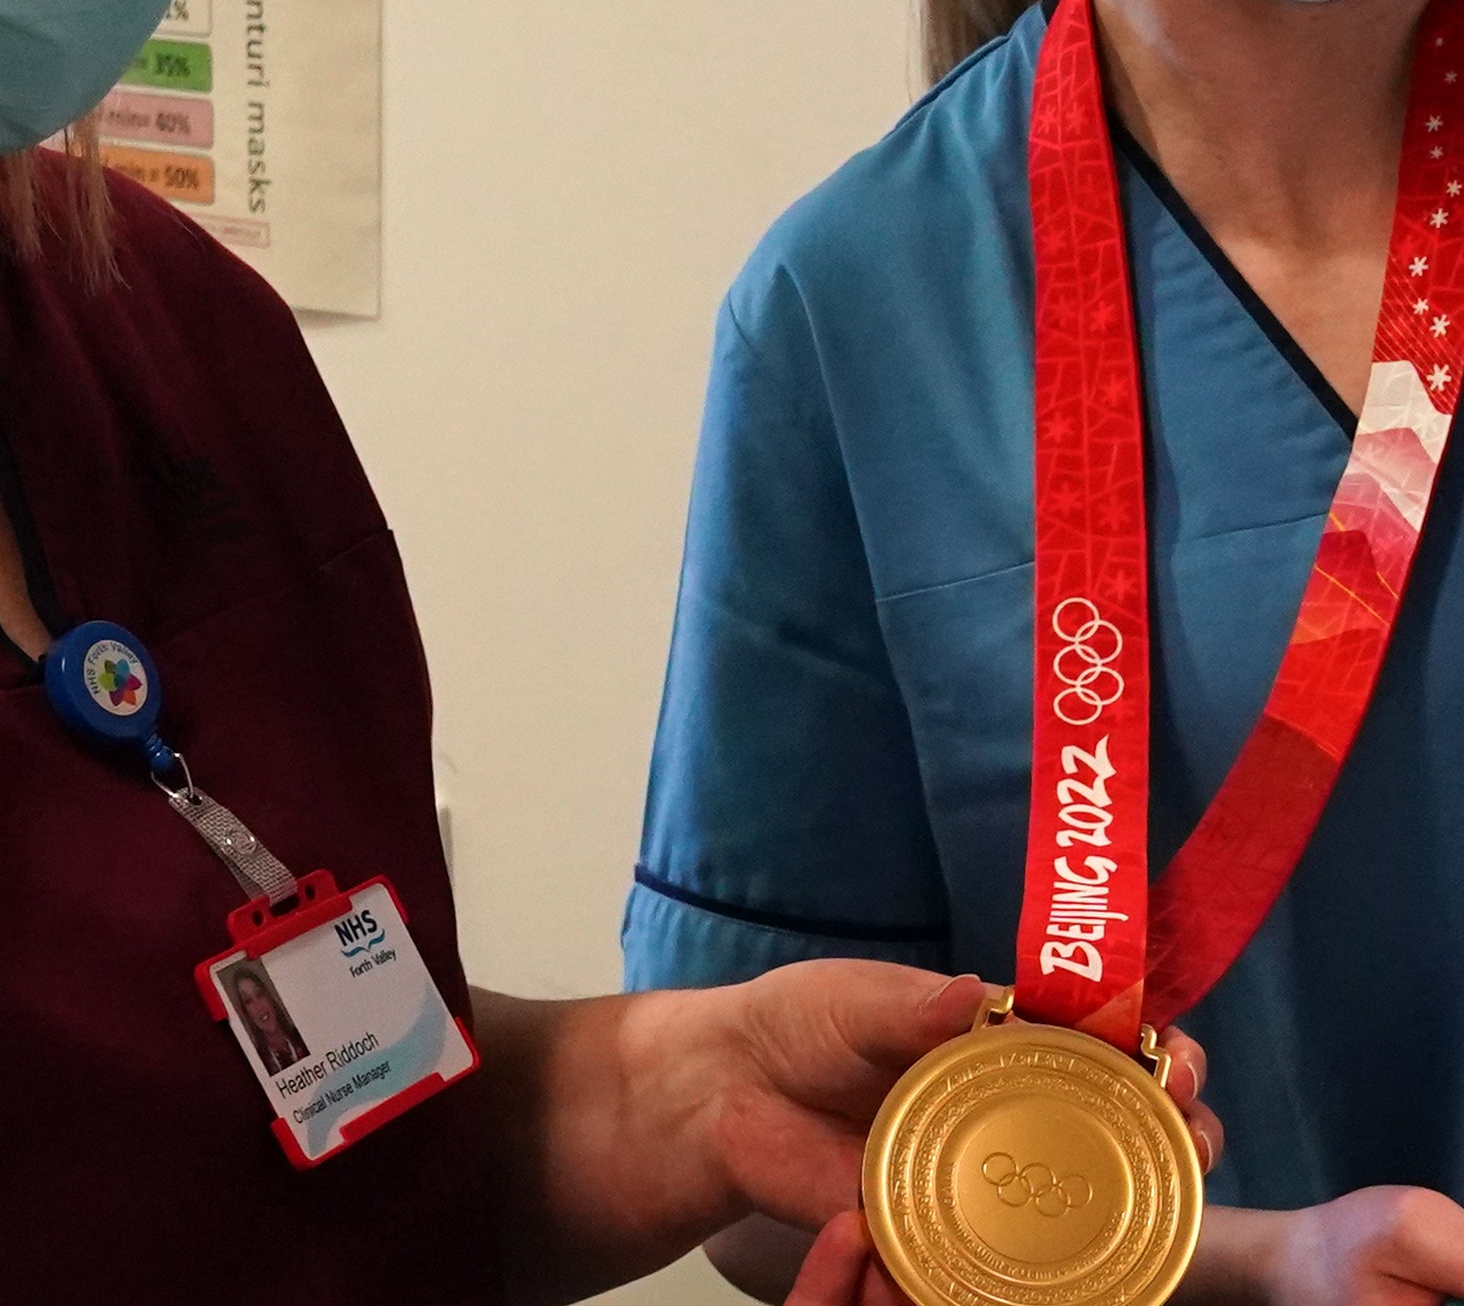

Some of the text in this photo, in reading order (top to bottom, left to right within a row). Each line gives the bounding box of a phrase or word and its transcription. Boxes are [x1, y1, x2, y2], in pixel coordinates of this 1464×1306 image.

[246, 101, 272, 216] masks
[1039, 734, 1129, 983] BEIJING 2022
[334, 909, 379, 947] NHS
[350, 947, 397, 978] Forth Valley
[275, 1031, 380, 1100] Heather Riddoch
[292, 1059, 392, 1125] Clinical Nurse Manager
